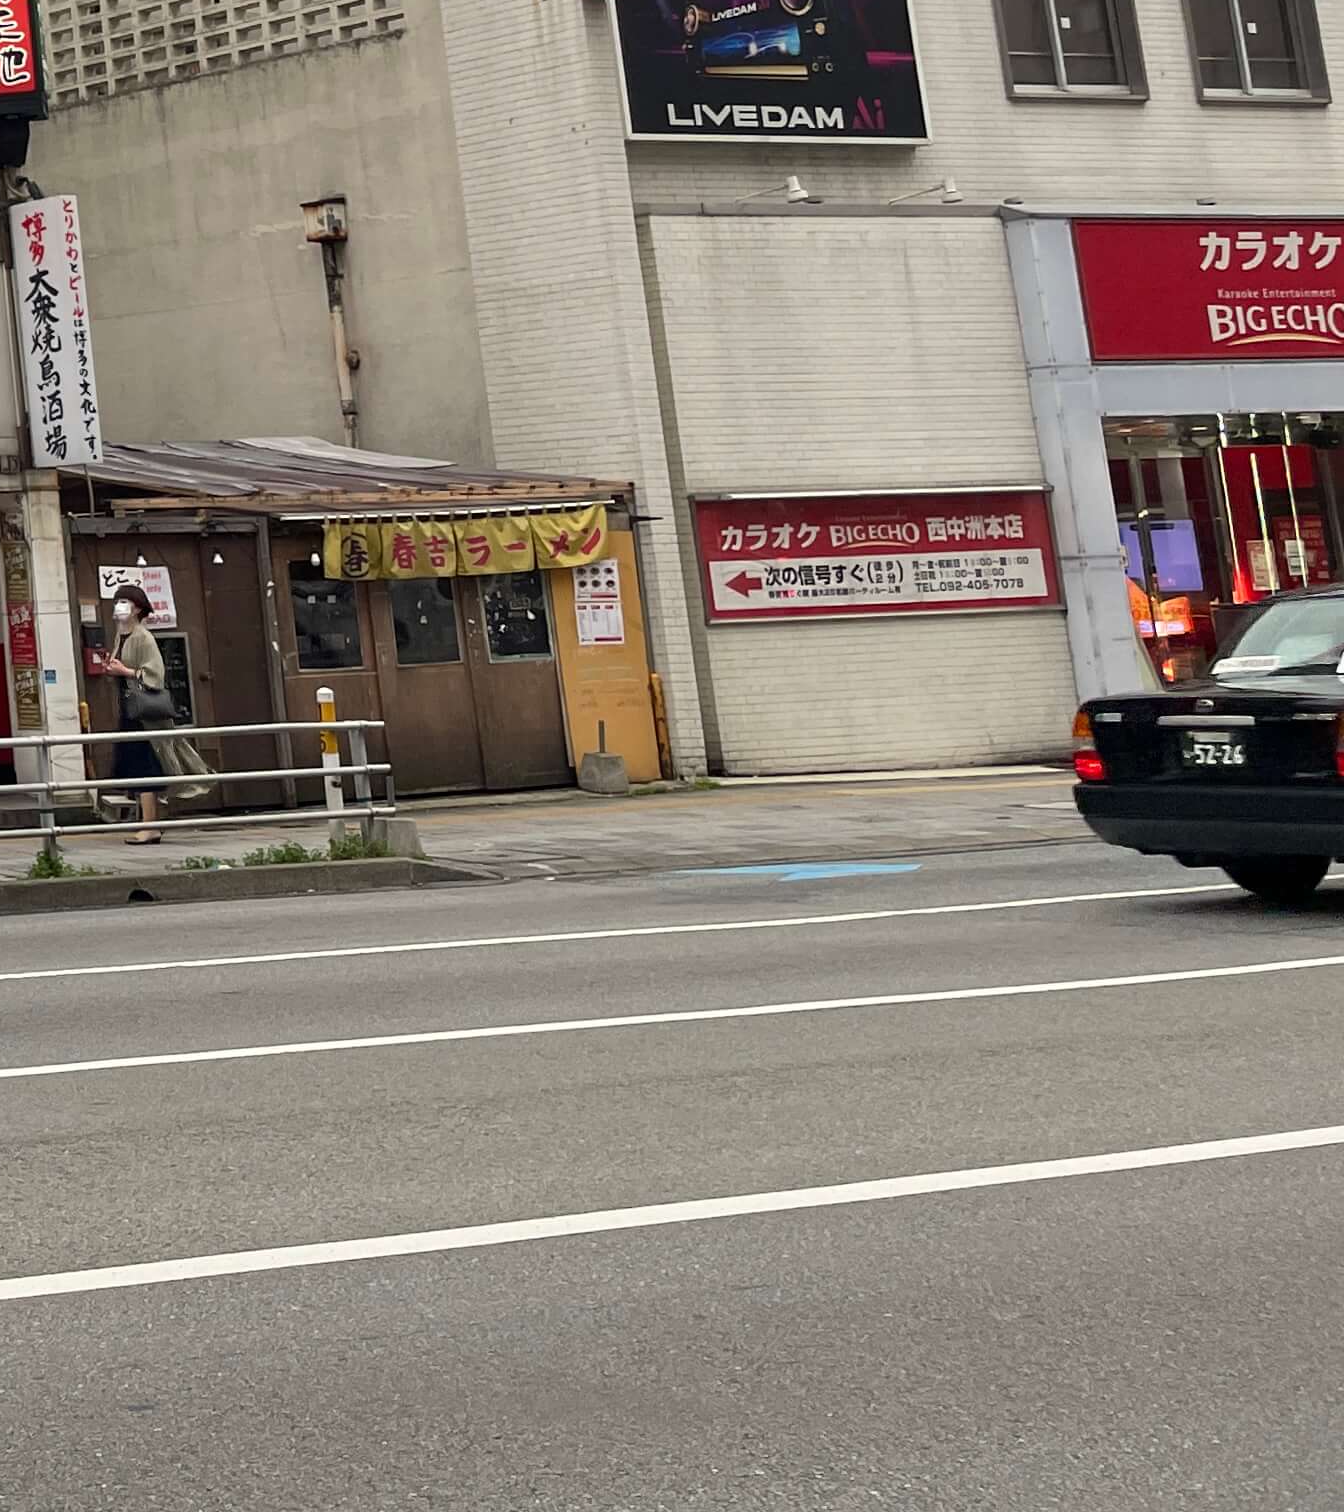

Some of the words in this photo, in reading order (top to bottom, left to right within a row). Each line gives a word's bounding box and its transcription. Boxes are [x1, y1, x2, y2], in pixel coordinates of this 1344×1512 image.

[666, 102, 845, 130] LIVEDAM
[1198, 230, 1342, 271] カラオケ
[1207, 304, 1268, 343] BIG
[720, 521, 820, 552] カラオケ
[829, 524, 867, 548] BIG
[868, 522, 921, 544] ECHO
[925, 514, 1025, 543] 西中洲本店
[391, 527, 602, 570] 春吉ラーメン
[763, 562, 864, 588] 次の信号すぐ
